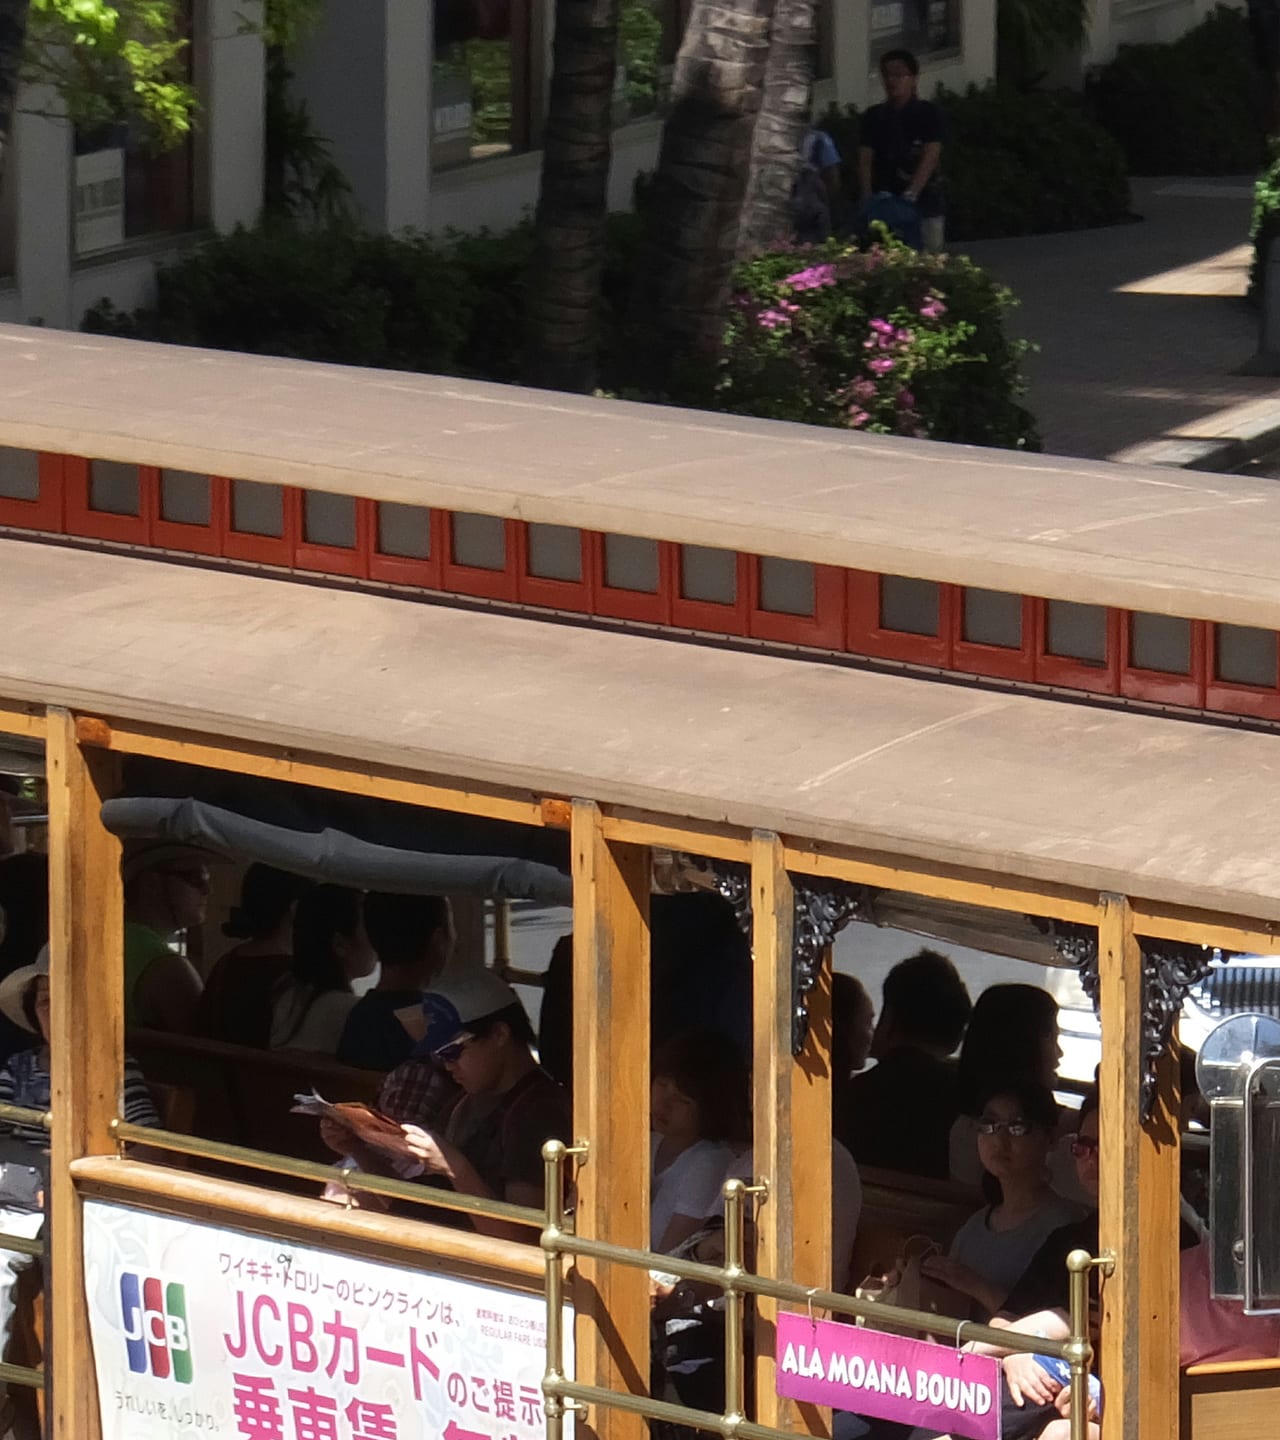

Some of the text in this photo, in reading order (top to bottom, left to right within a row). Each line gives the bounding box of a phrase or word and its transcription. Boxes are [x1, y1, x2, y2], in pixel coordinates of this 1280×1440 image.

[223, 1290, 543, 1427] JCBカードのご提示
[782, 1341, 992, 1416] ALA MOANA BOUND
